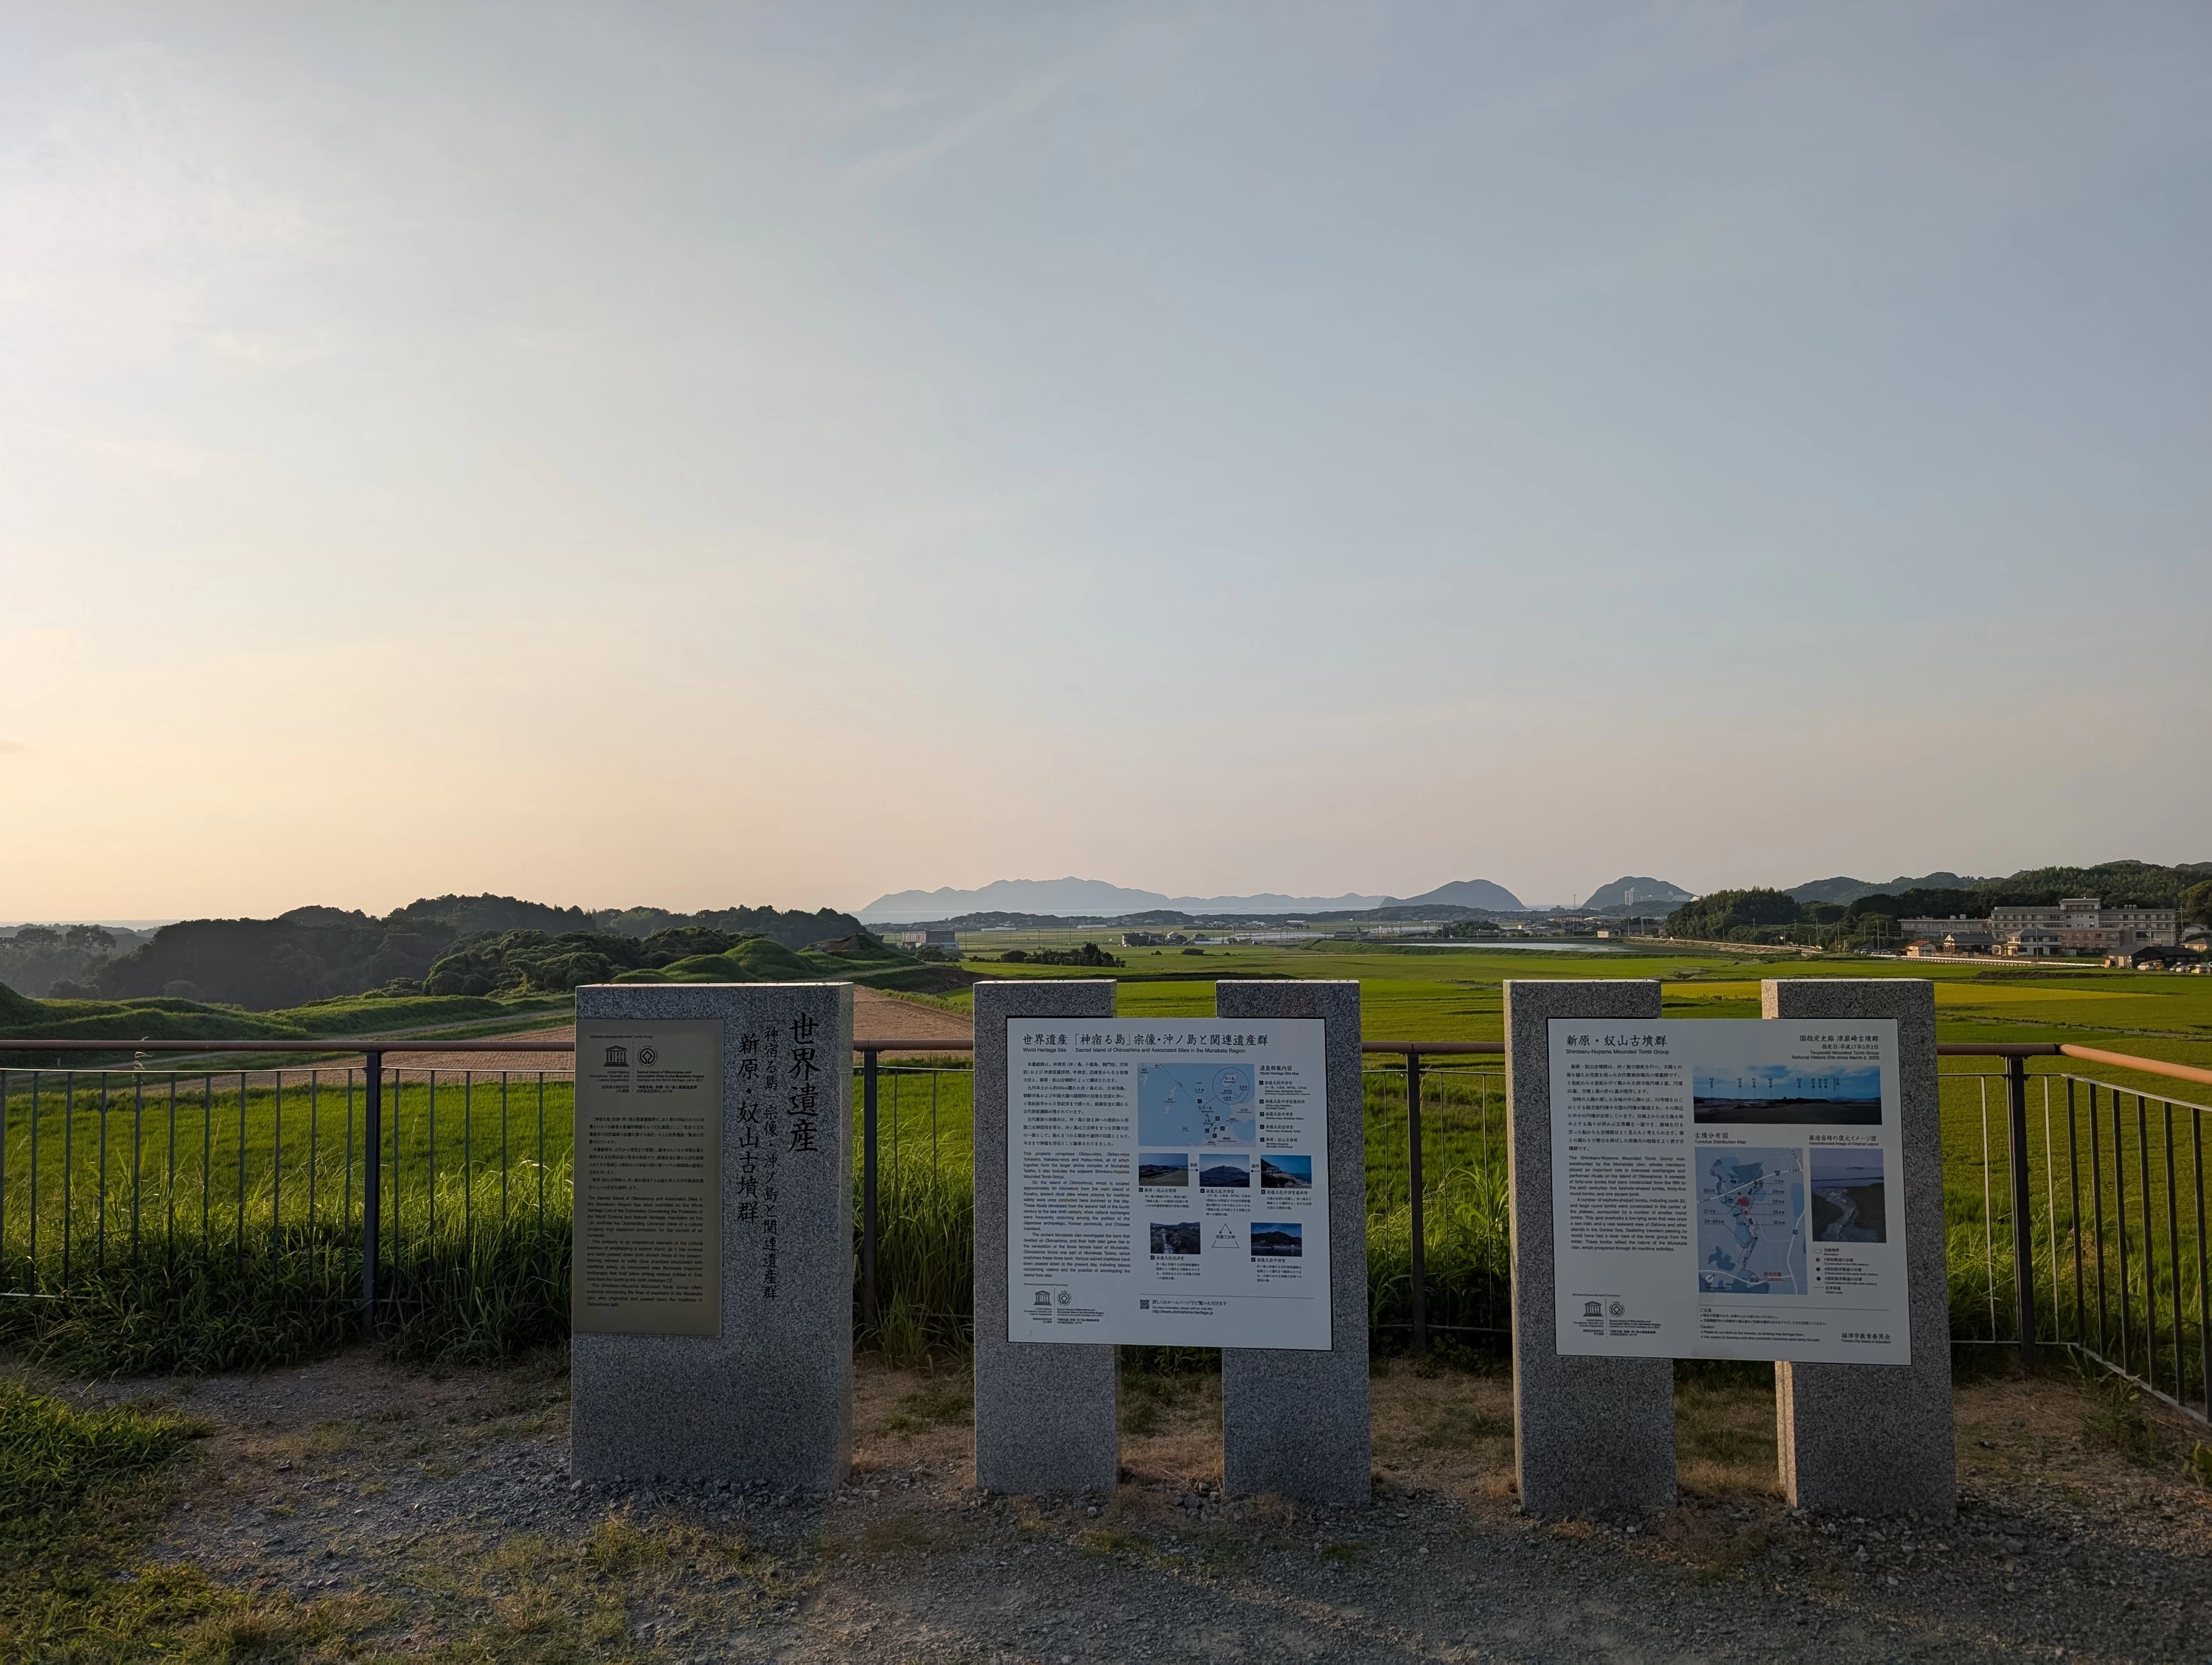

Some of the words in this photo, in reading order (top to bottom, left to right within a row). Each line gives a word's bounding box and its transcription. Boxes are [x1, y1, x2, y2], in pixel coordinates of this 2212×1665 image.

[1023, 1033, 1067, 1045] 世界遺産
[1567, 1035, 1667, 1047] 新原・奴山古墳群
[787, 1012, 821, 1153] 世界遺産
[737, 1033, 760, 1224] 新原・奴山古墳群
